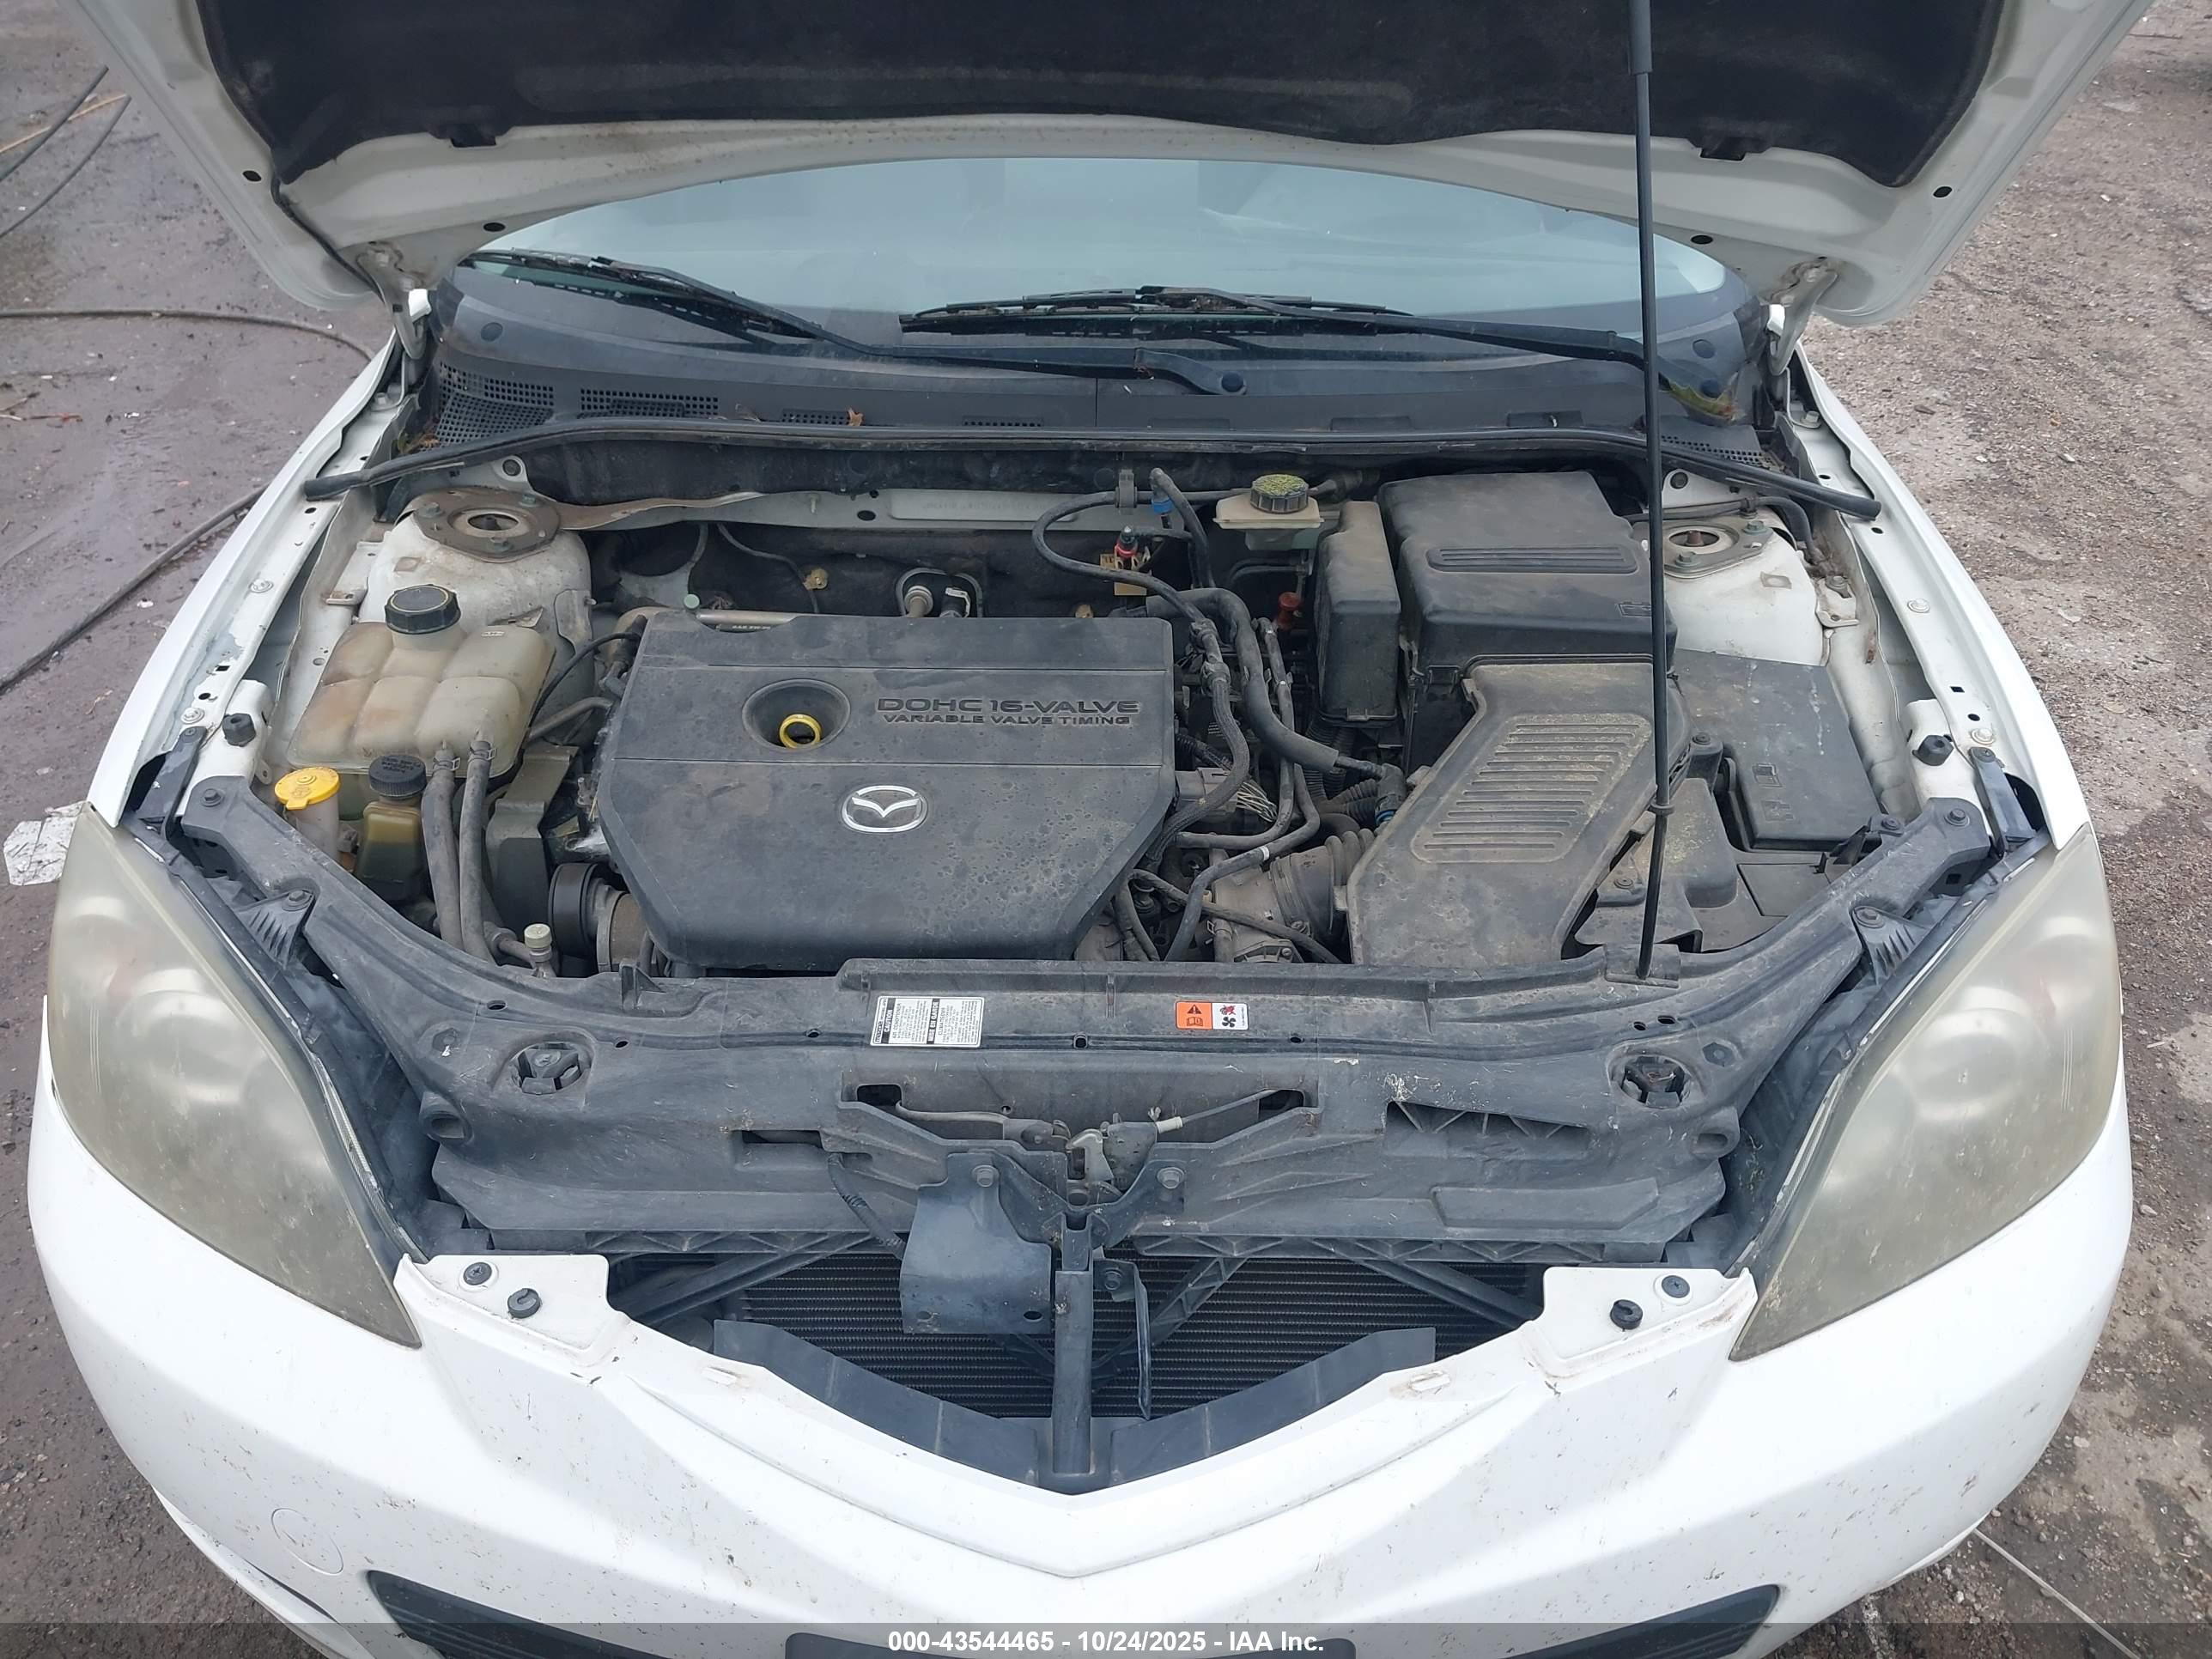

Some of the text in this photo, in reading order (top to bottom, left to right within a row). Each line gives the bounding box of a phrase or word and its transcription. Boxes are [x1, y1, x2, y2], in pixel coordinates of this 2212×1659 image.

[878, 698, 1139, 714] DOHC 16-VALVE
[884, 714, 1131, 725] VARIABLE VALVE TIMING
[931, 1001, 939, 1019] GARDE
[884, 1009, 893, 1032] CAUTION
